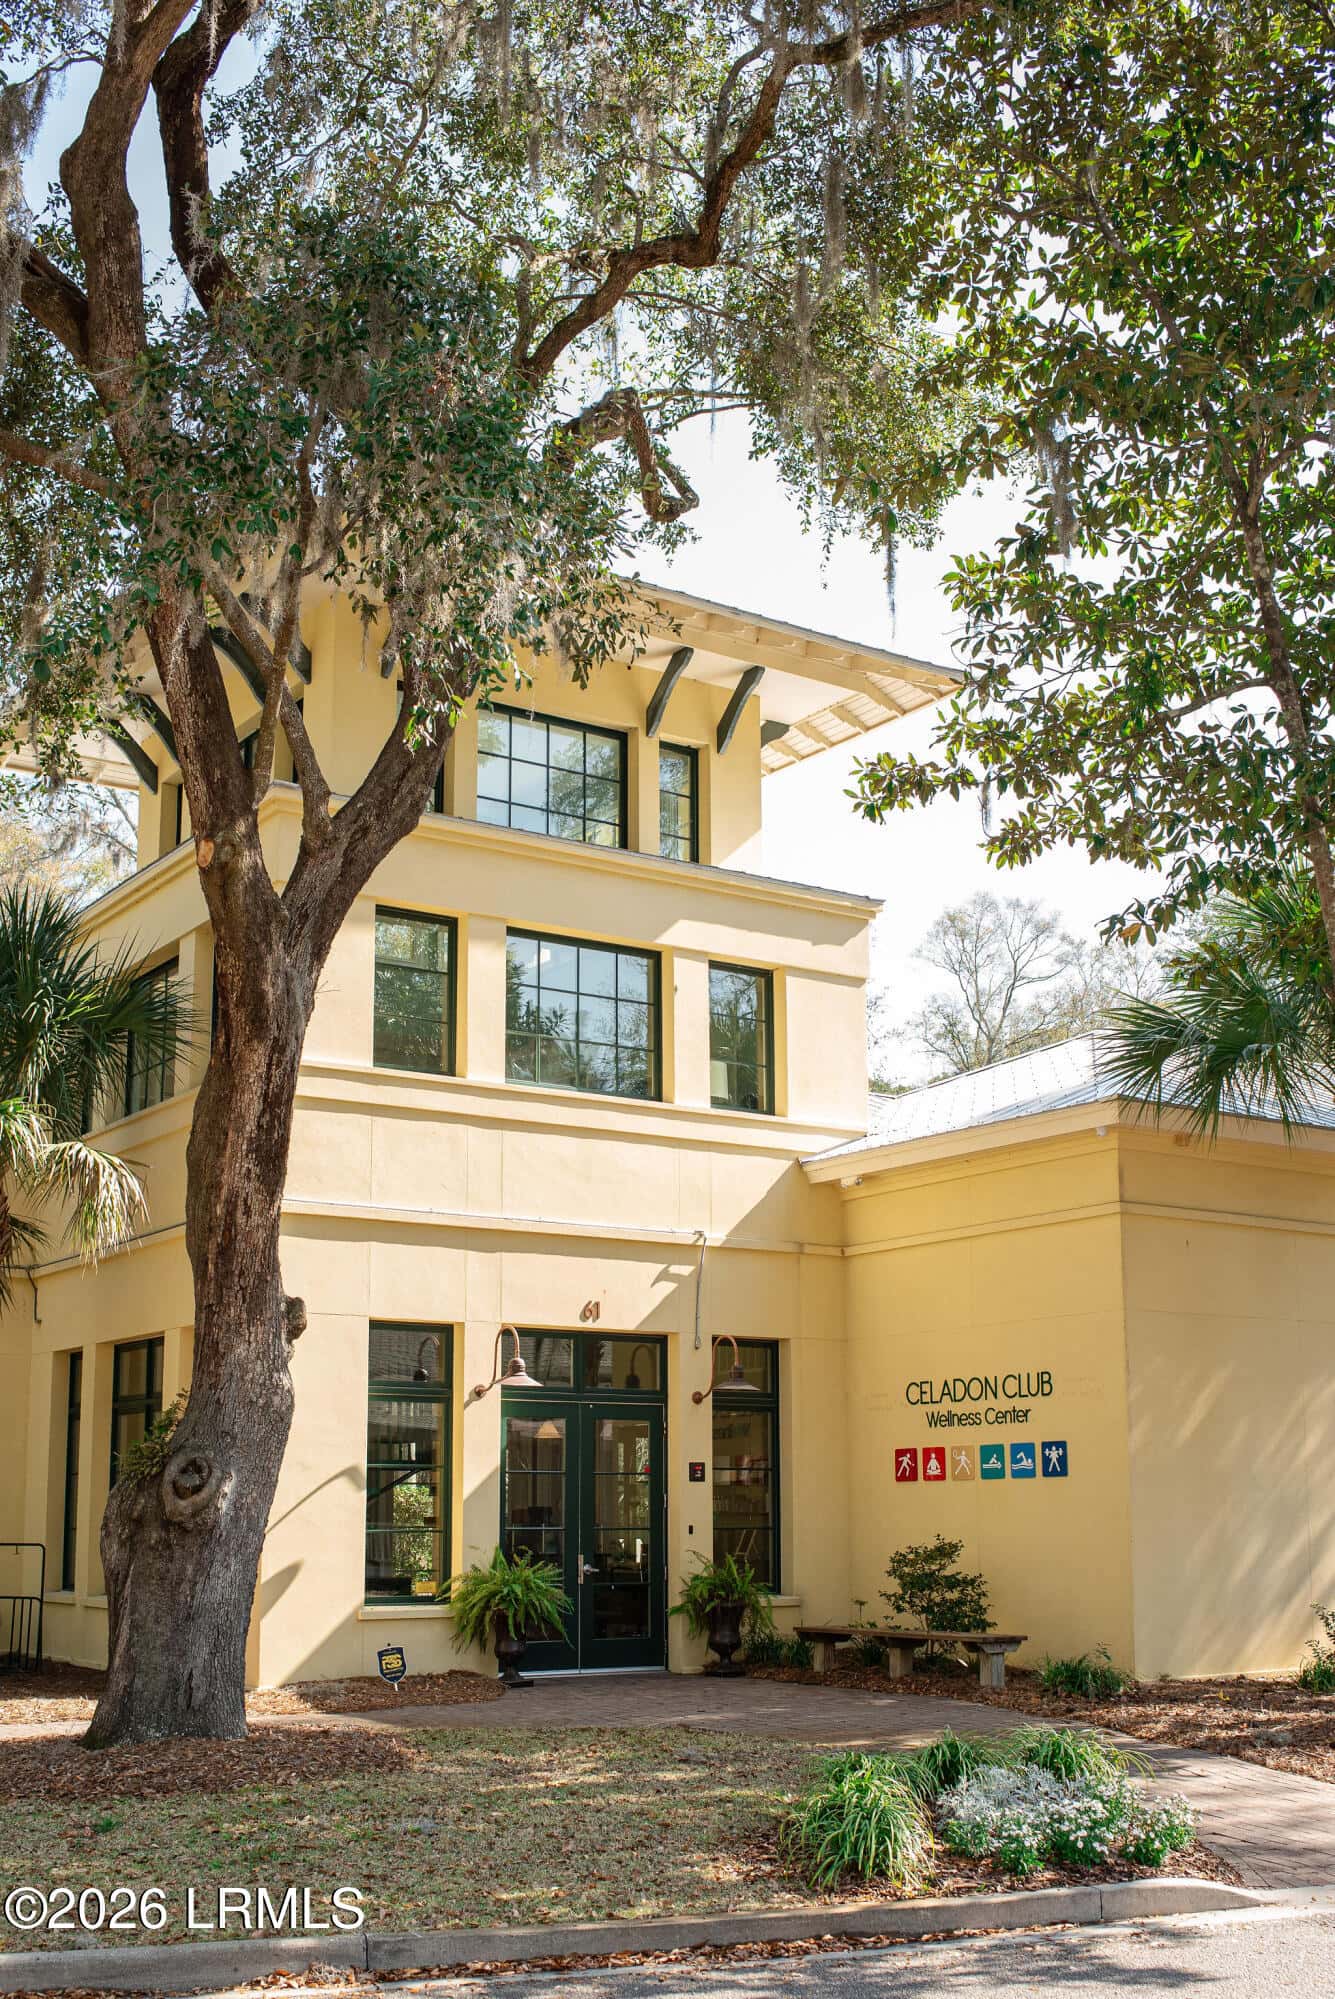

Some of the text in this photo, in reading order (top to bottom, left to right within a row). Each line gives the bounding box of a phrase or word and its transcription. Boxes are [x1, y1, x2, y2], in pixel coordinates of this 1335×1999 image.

[581, 1300, 601, 1321] 61
[906, 1371, 1054, 1405] CELADON CLUB
[926, 1406, 1031, 1428] Wellness Center
